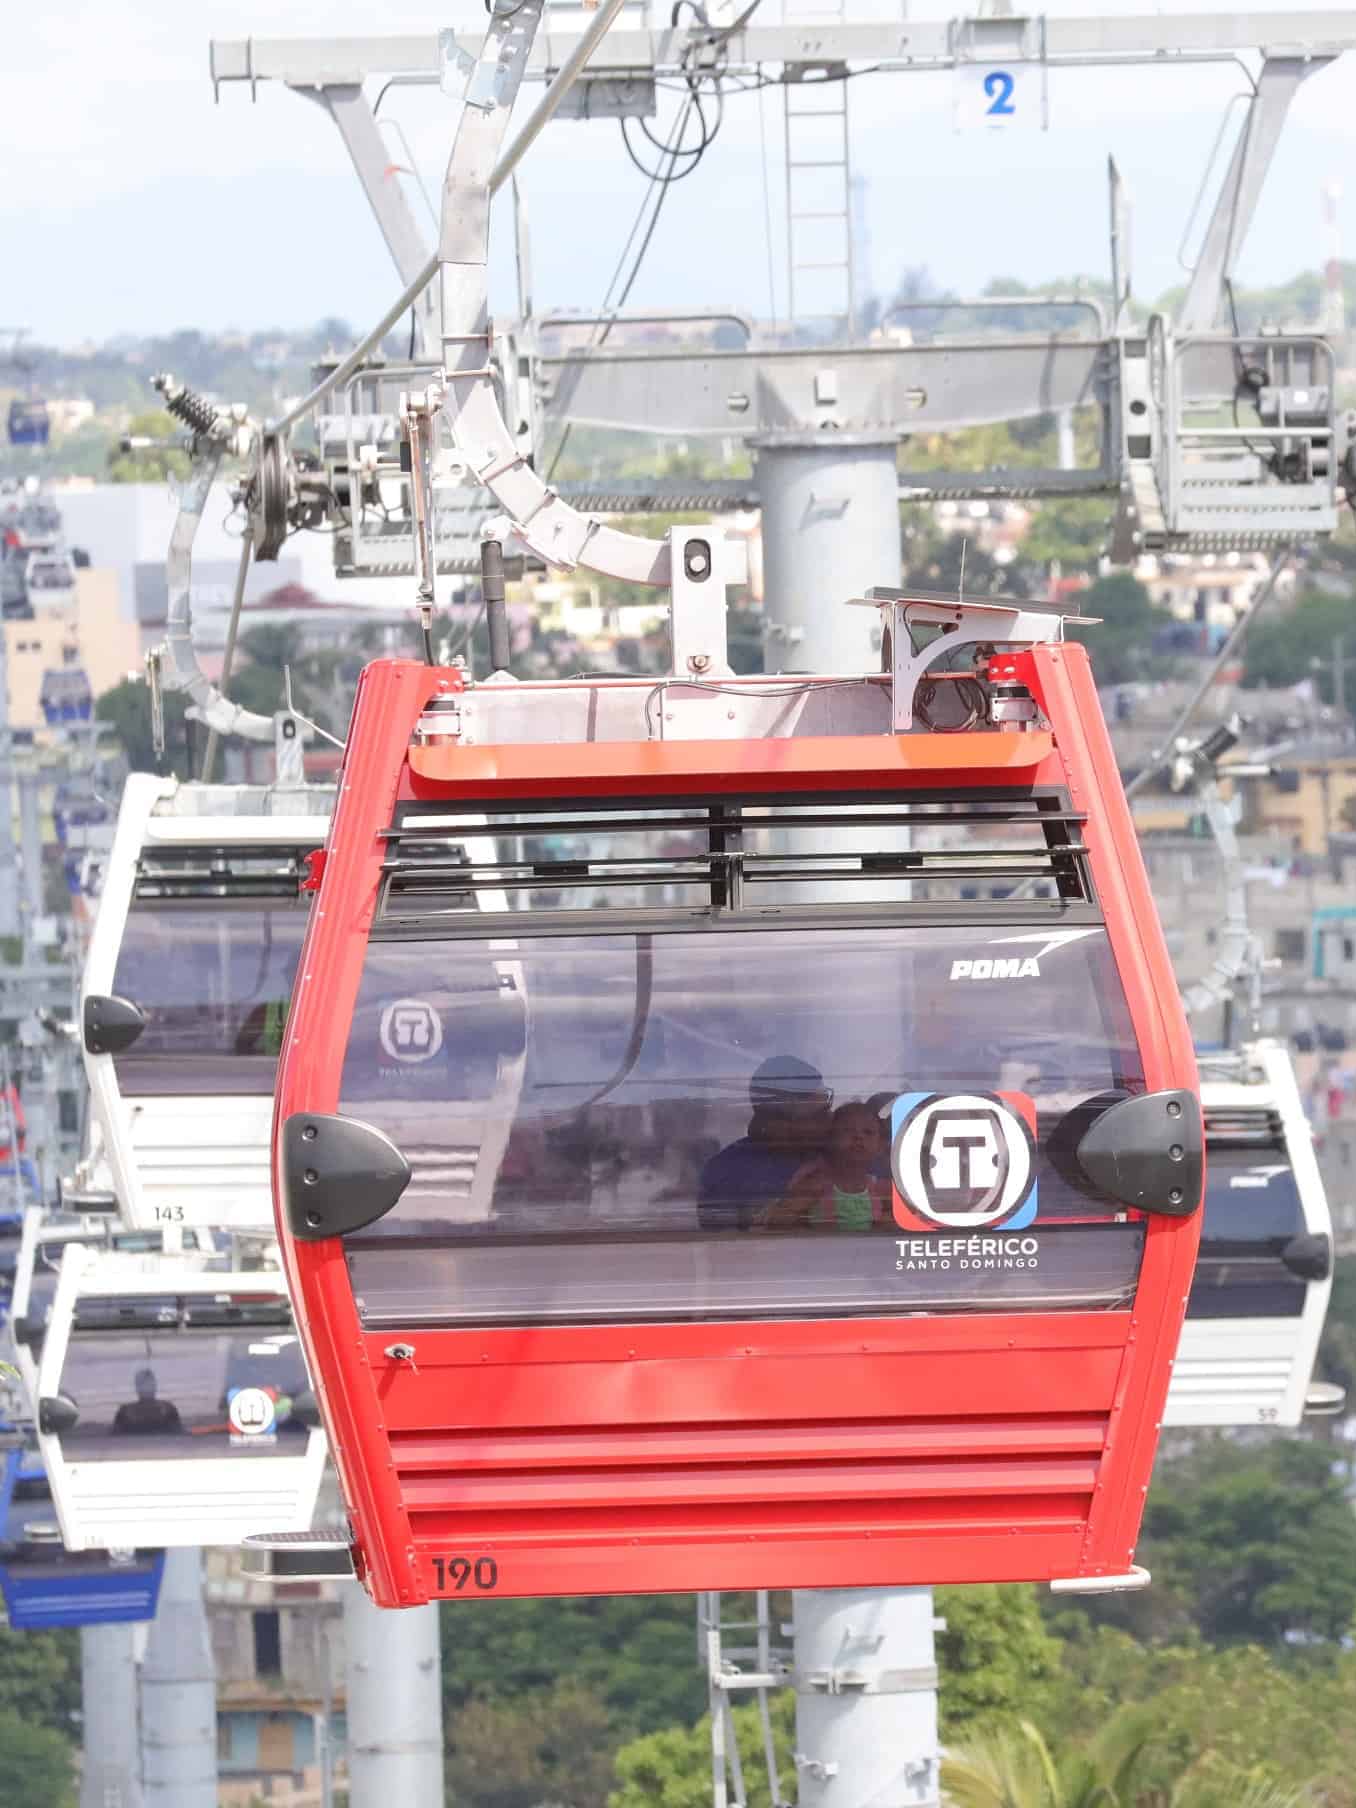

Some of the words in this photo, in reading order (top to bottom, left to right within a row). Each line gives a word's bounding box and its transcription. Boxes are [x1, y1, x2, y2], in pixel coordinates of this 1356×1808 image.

[983, 71, 1016, 115] 2
[950, 957, 1040, 981] POMA
[153, 1205, 185, 1222] 143
[895, 1234, 1039, 1257] TELEFÉRICO
[895, 1259, 951, 1270] SANTO
[960, 1257, 1039, 1269] DOMINGO
[432, 1557, 498, 1591] 190
